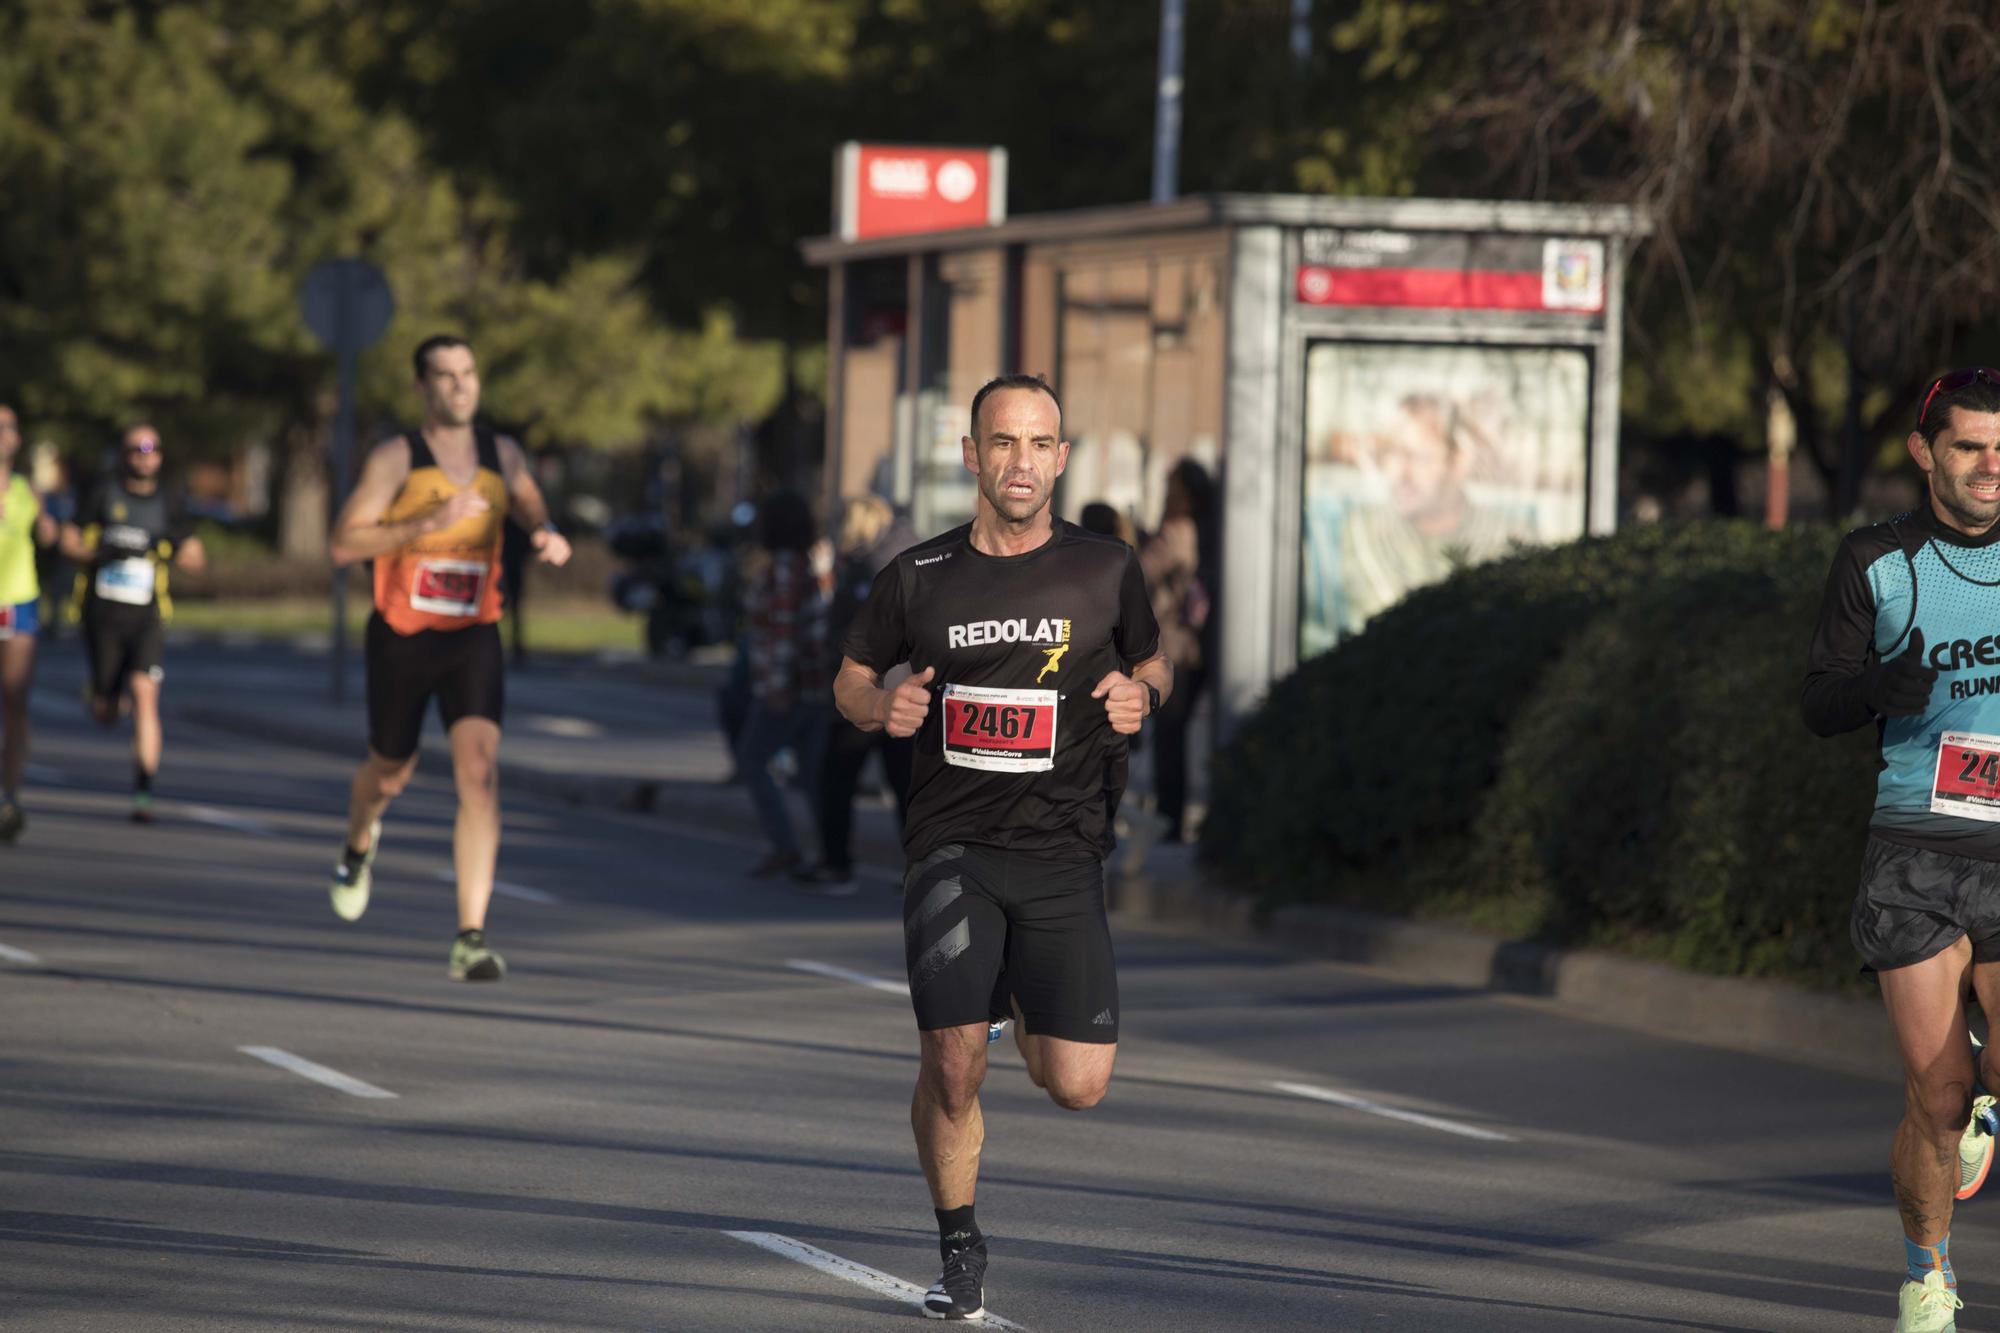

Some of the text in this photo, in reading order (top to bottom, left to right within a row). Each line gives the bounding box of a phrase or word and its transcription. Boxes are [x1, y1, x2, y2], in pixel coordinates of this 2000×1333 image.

[915, 554, 943, 566] luanvi
[948, 618, 1063, 649] REDOLAT
[962, 703, 1036, 739] 2467
